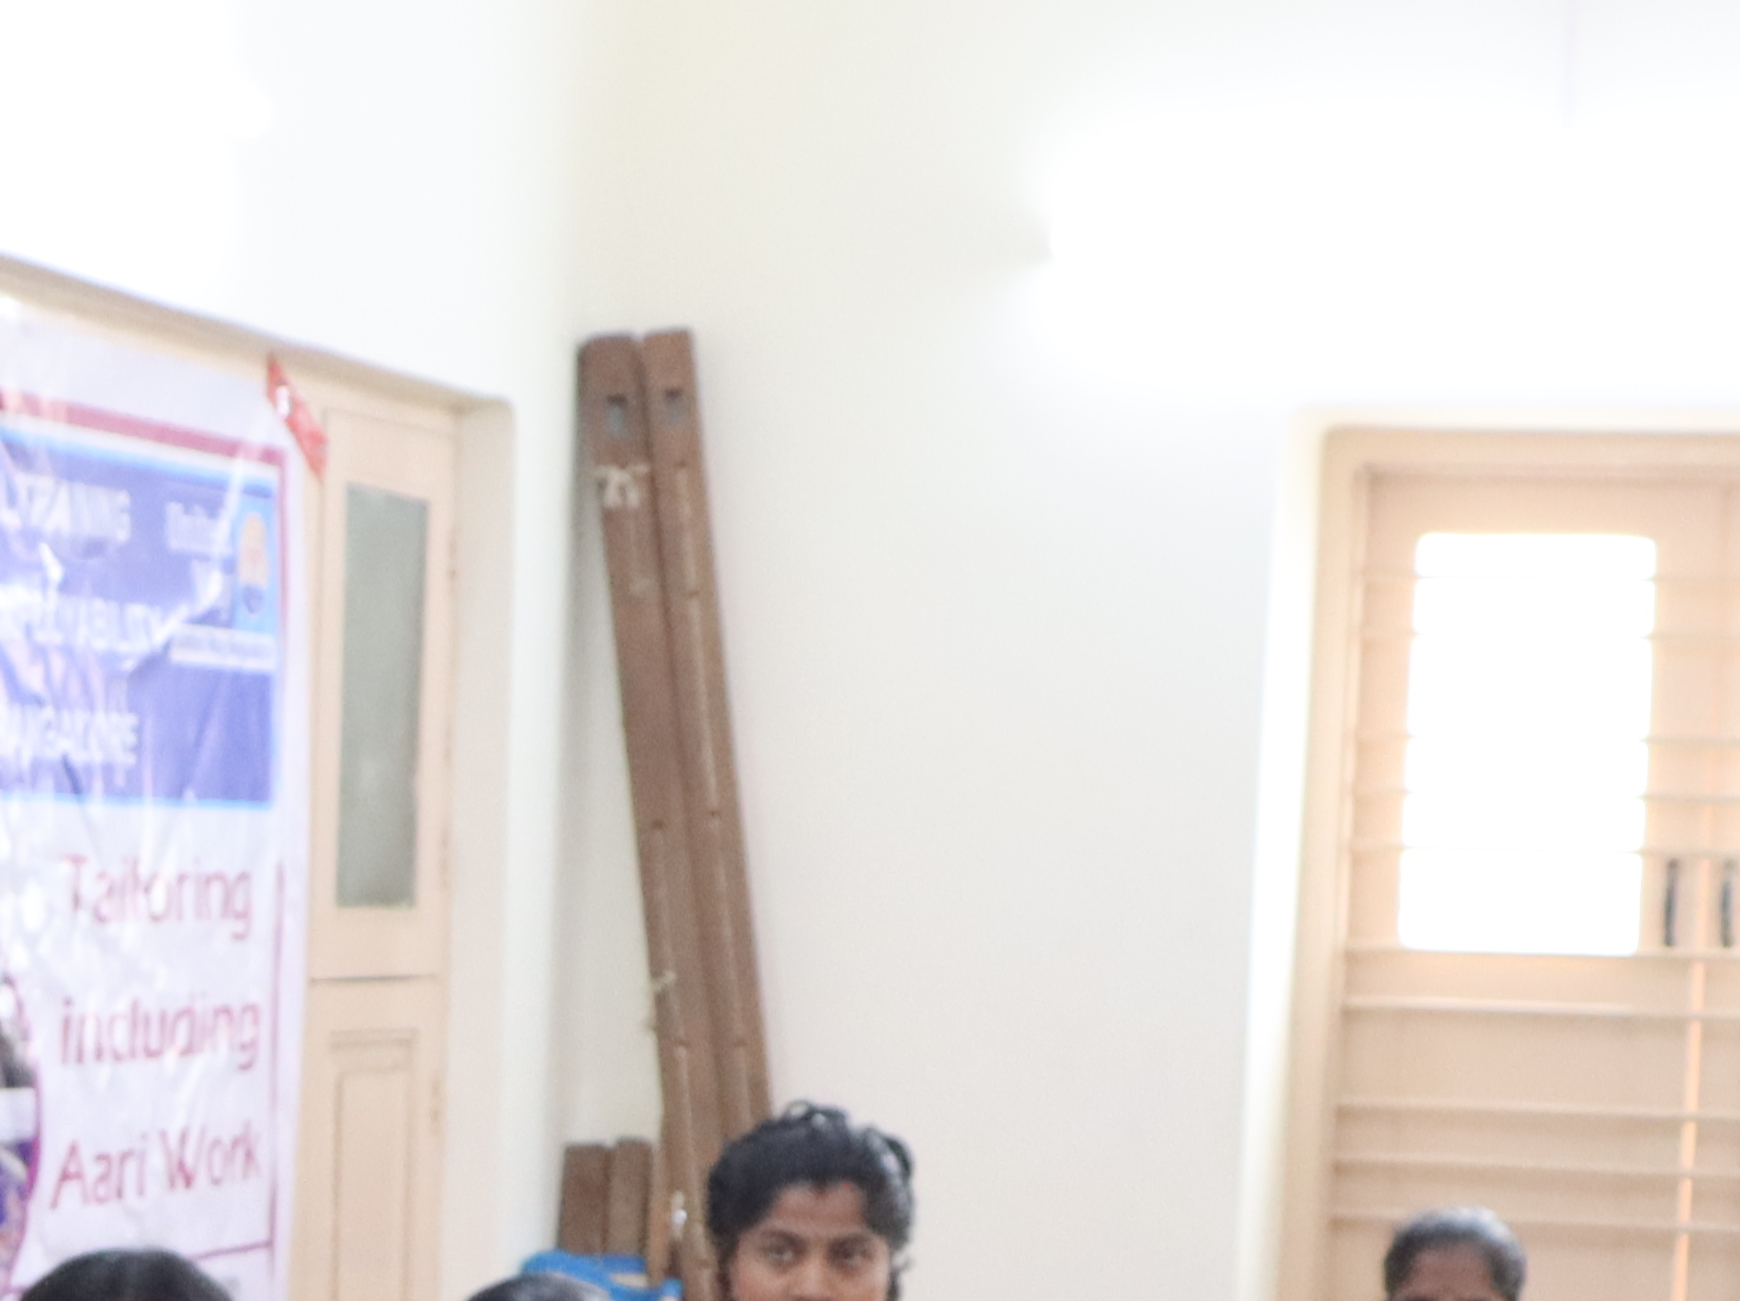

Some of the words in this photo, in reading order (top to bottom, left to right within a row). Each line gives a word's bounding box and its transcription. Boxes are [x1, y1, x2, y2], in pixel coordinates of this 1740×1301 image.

[61, 853, 251, 941] Tailoring
[60, 994, 260, 1071] including
[50, 1132, 147, 1209] Aari
[158, 1119, 260, 1191] Work
